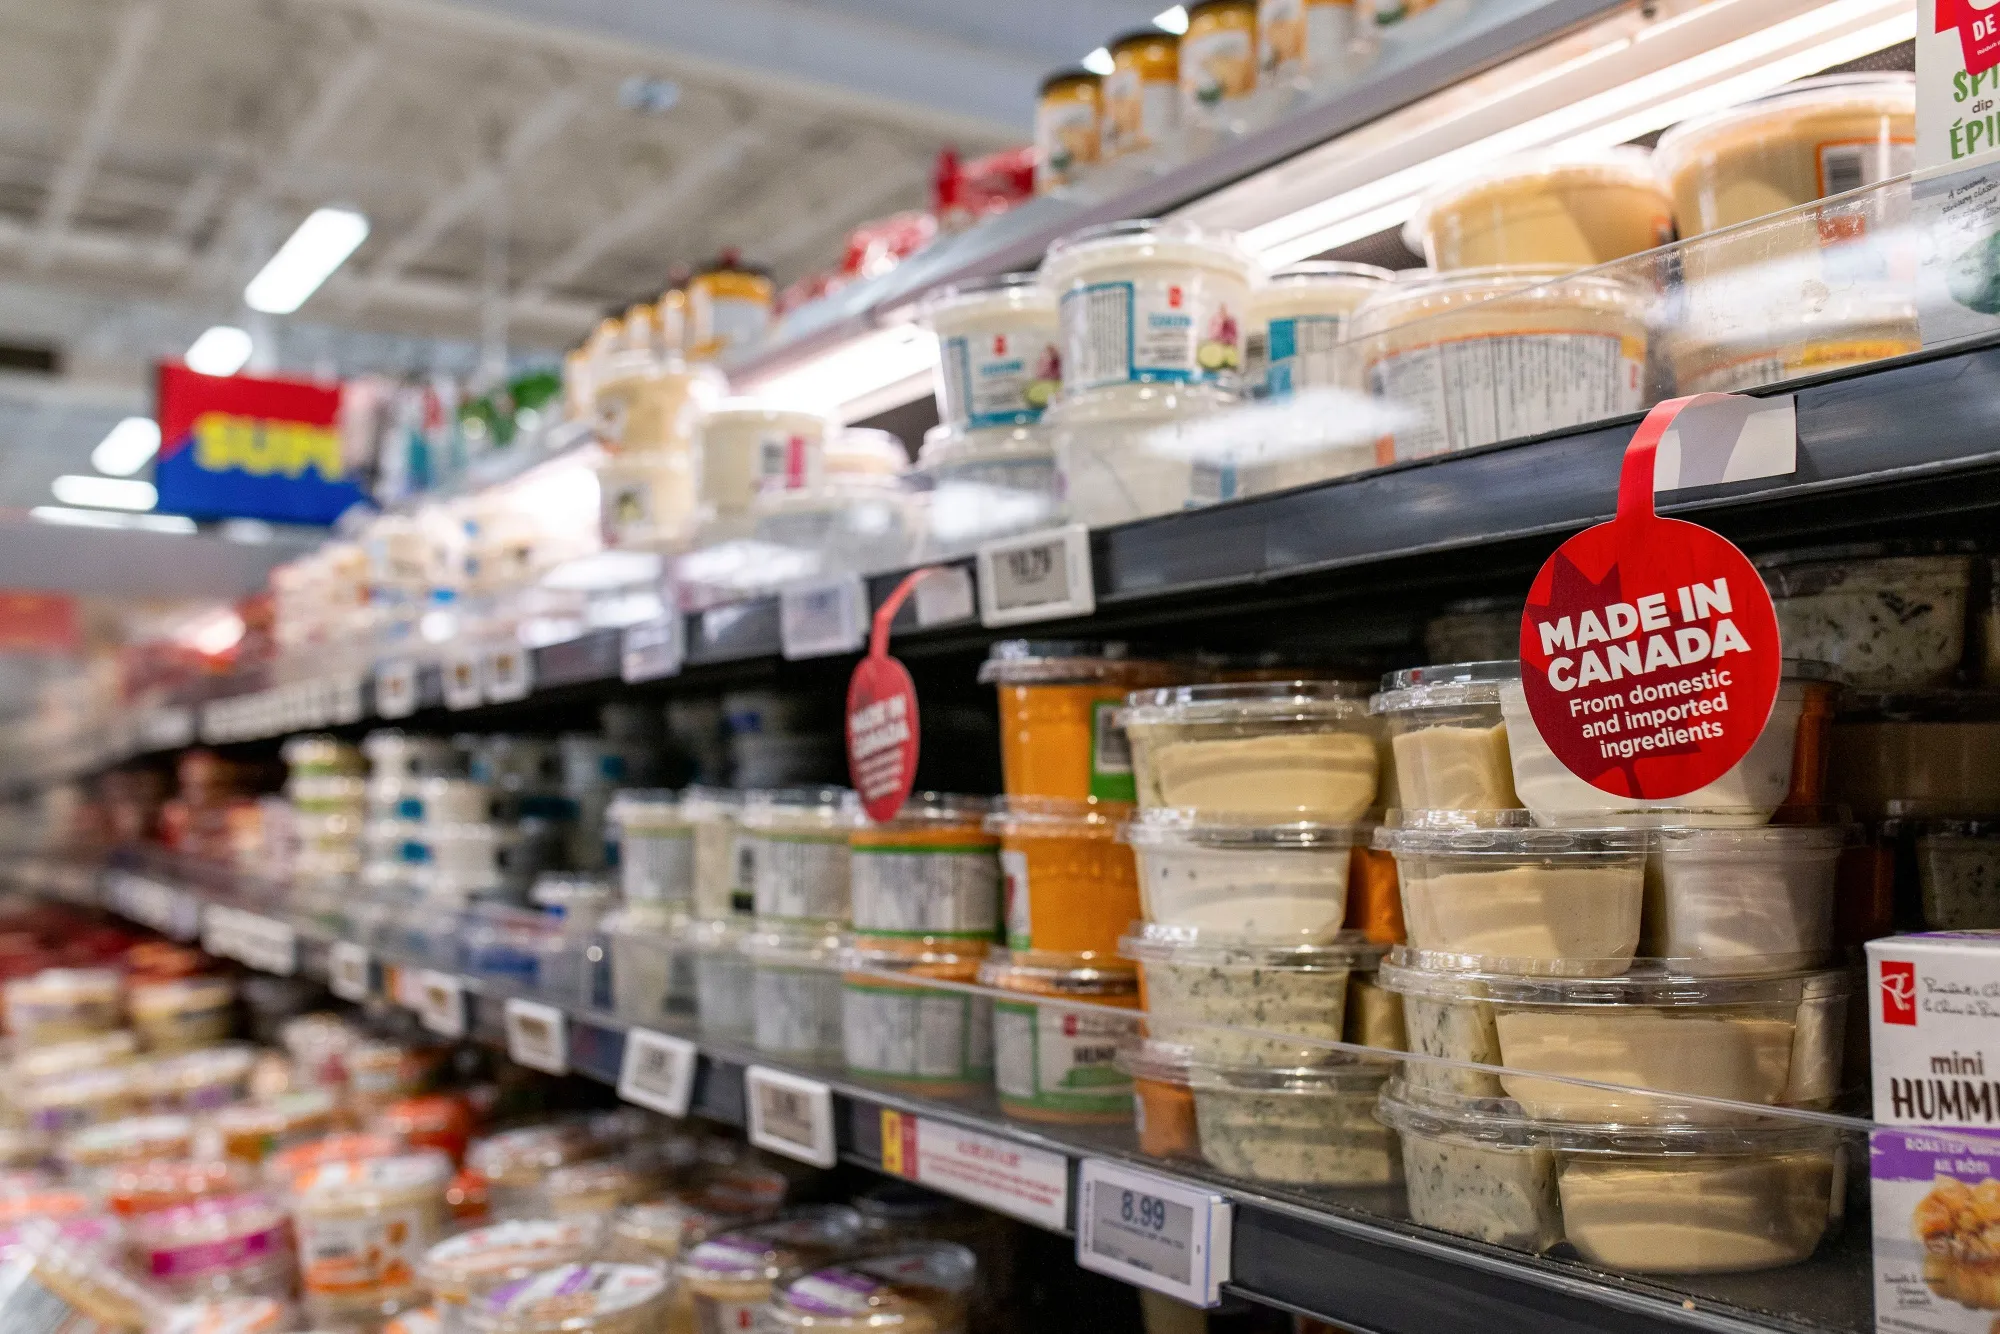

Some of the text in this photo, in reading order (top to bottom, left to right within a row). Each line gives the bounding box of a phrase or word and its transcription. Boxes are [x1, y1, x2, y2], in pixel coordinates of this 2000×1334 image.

[1972, 13, 1998, 42] DE
[1972, 99, 1994, 114] dip
[1538, 577, 1733, 656] MADE IN
[1548, 618, 1752, 692] CANADA
[1569, 668, 1733, 718] From domestic
[1582, 691, 1729, 739] and imported
[1600, 720, 1724, 759] ingredients
[1930, 1050, 1984, 1076] mini
[1120, 1189, 1165, 1231] 8.99
